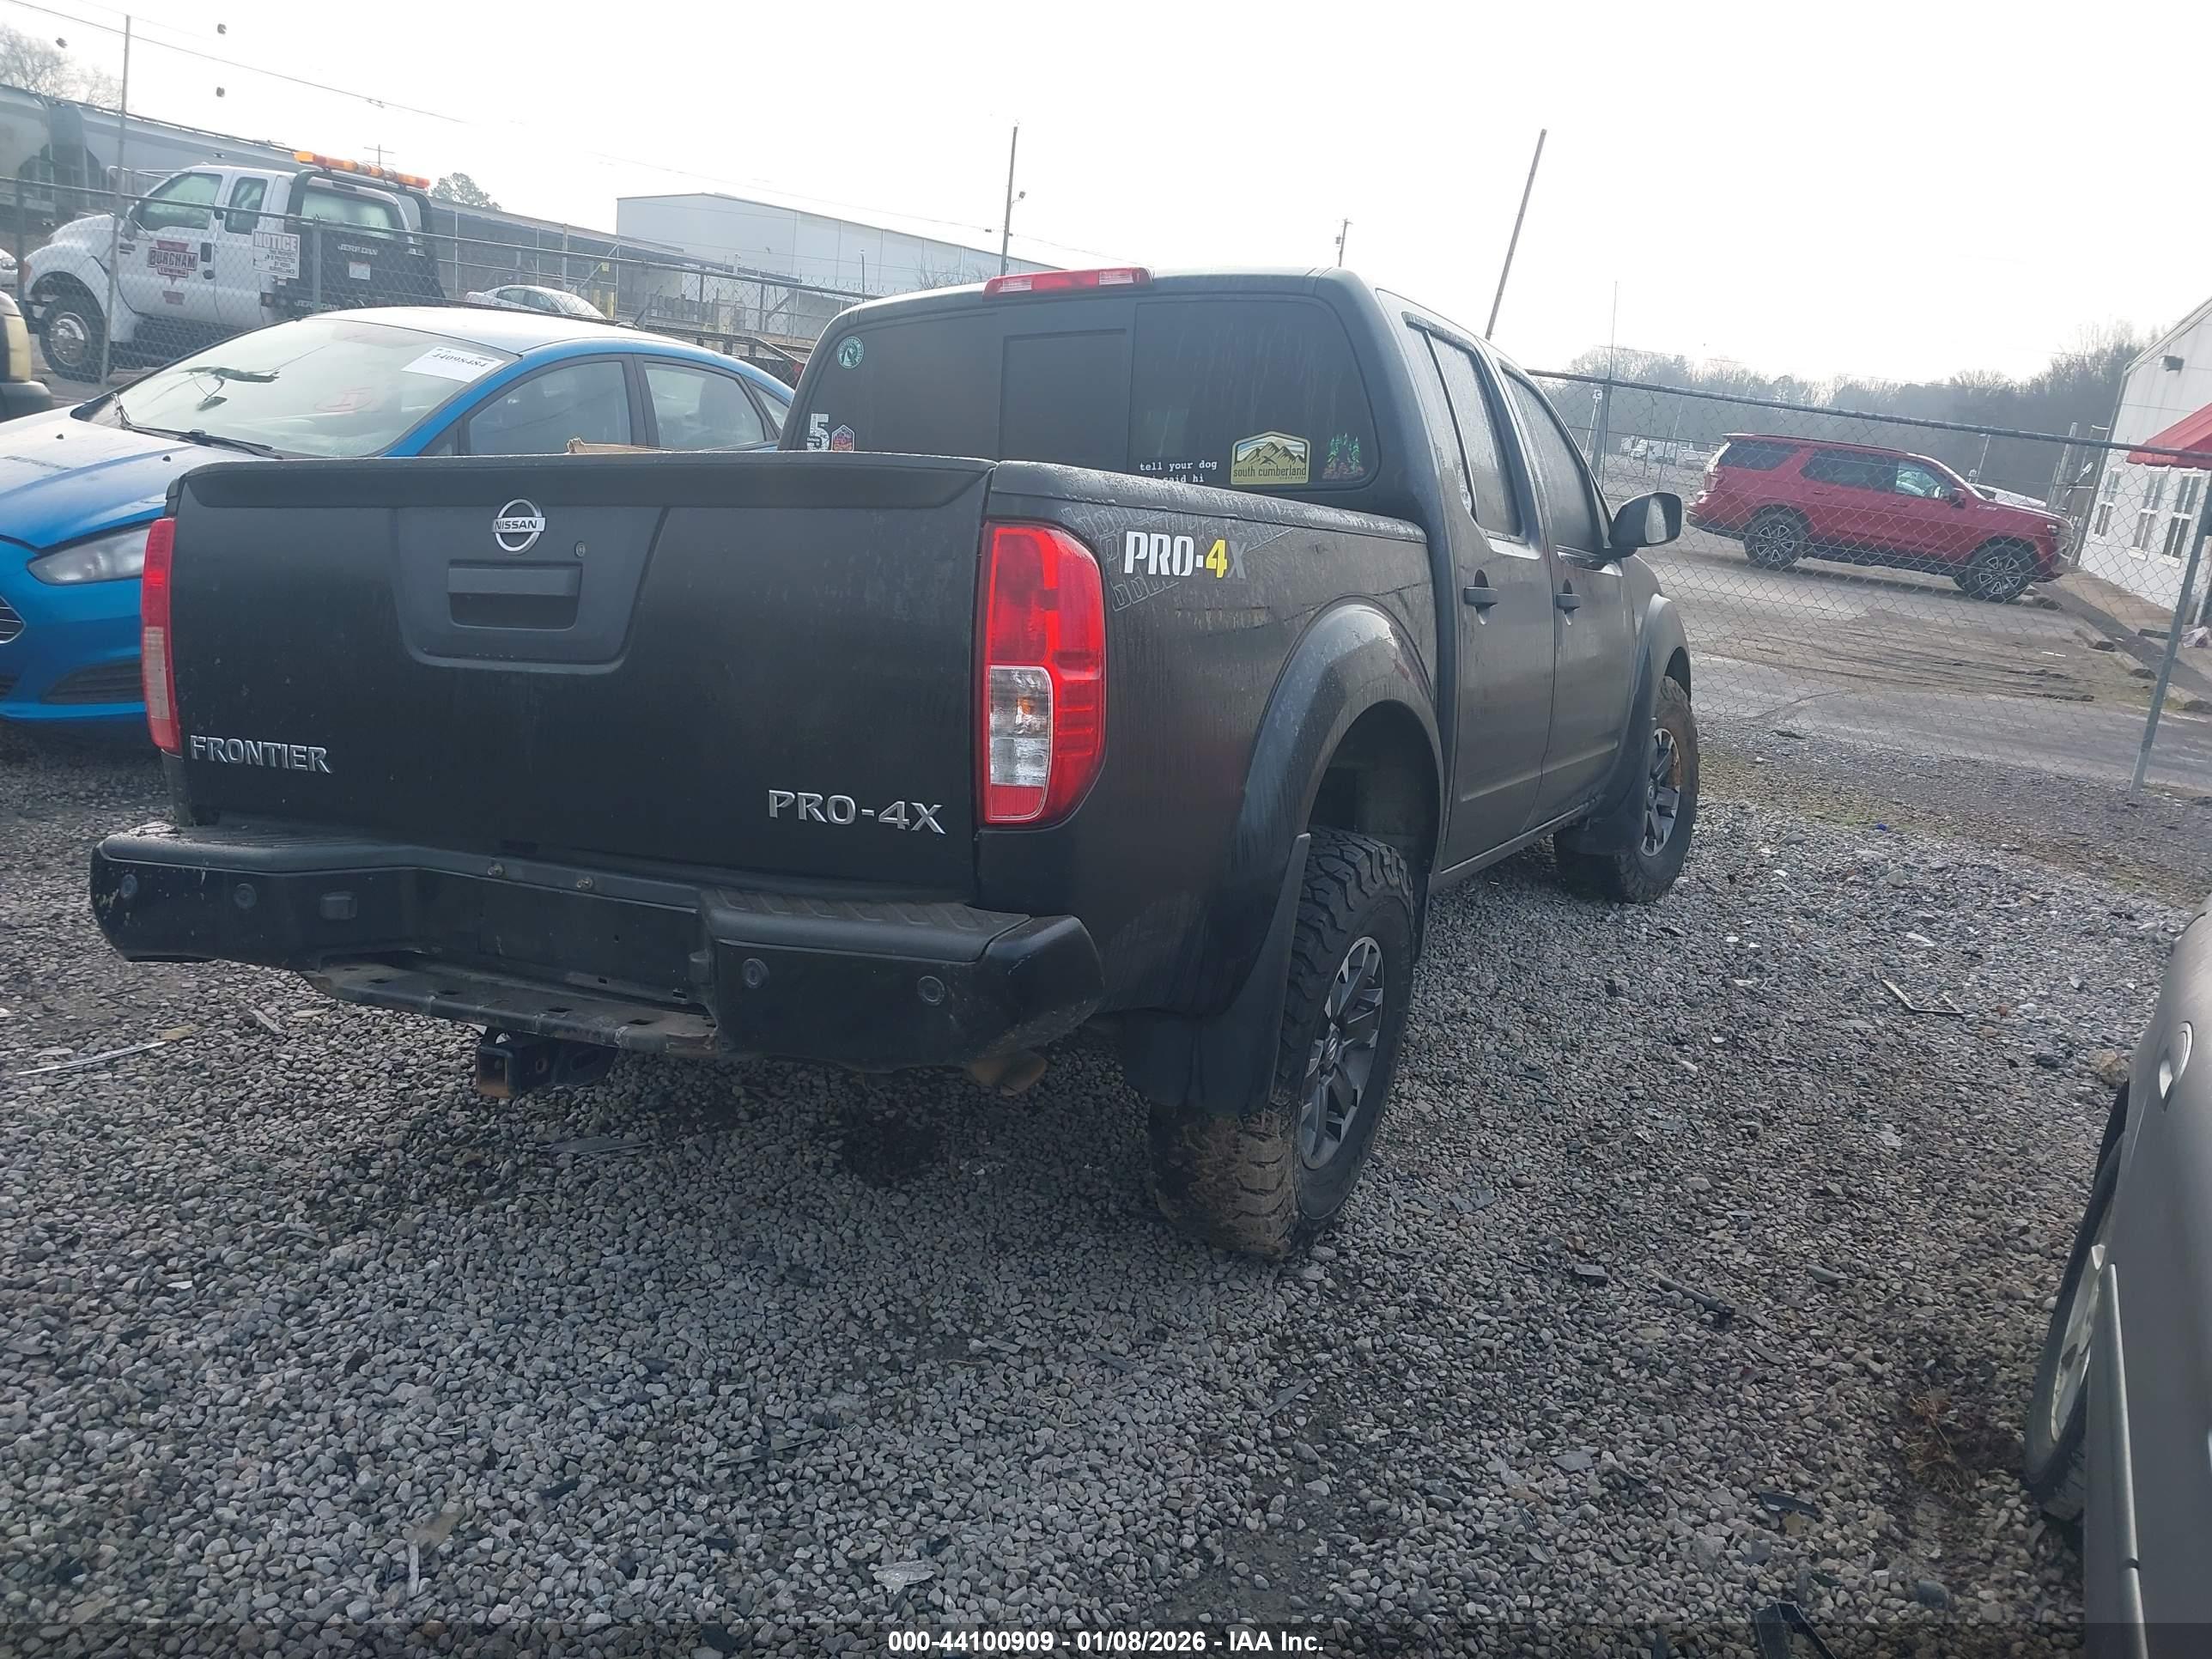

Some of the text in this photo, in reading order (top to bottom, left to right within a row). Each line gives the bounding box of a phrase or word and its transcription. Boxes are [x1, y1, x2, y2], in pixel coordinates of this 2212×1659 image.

[254, 233, 296, 252] NOTICE
[1139, 460, 1218, 471] tell your dog
[1233, 465, 1306, 477] south cumberland
[1192, 473, 1204, 483] hi
[495, 520, 538, 530] NISSAN
[1124, 531, 1249, 579] PRO-4X
[190, 734, 331, 774] FRONTIER
[769, 789, 946, 835] PRO-4X
